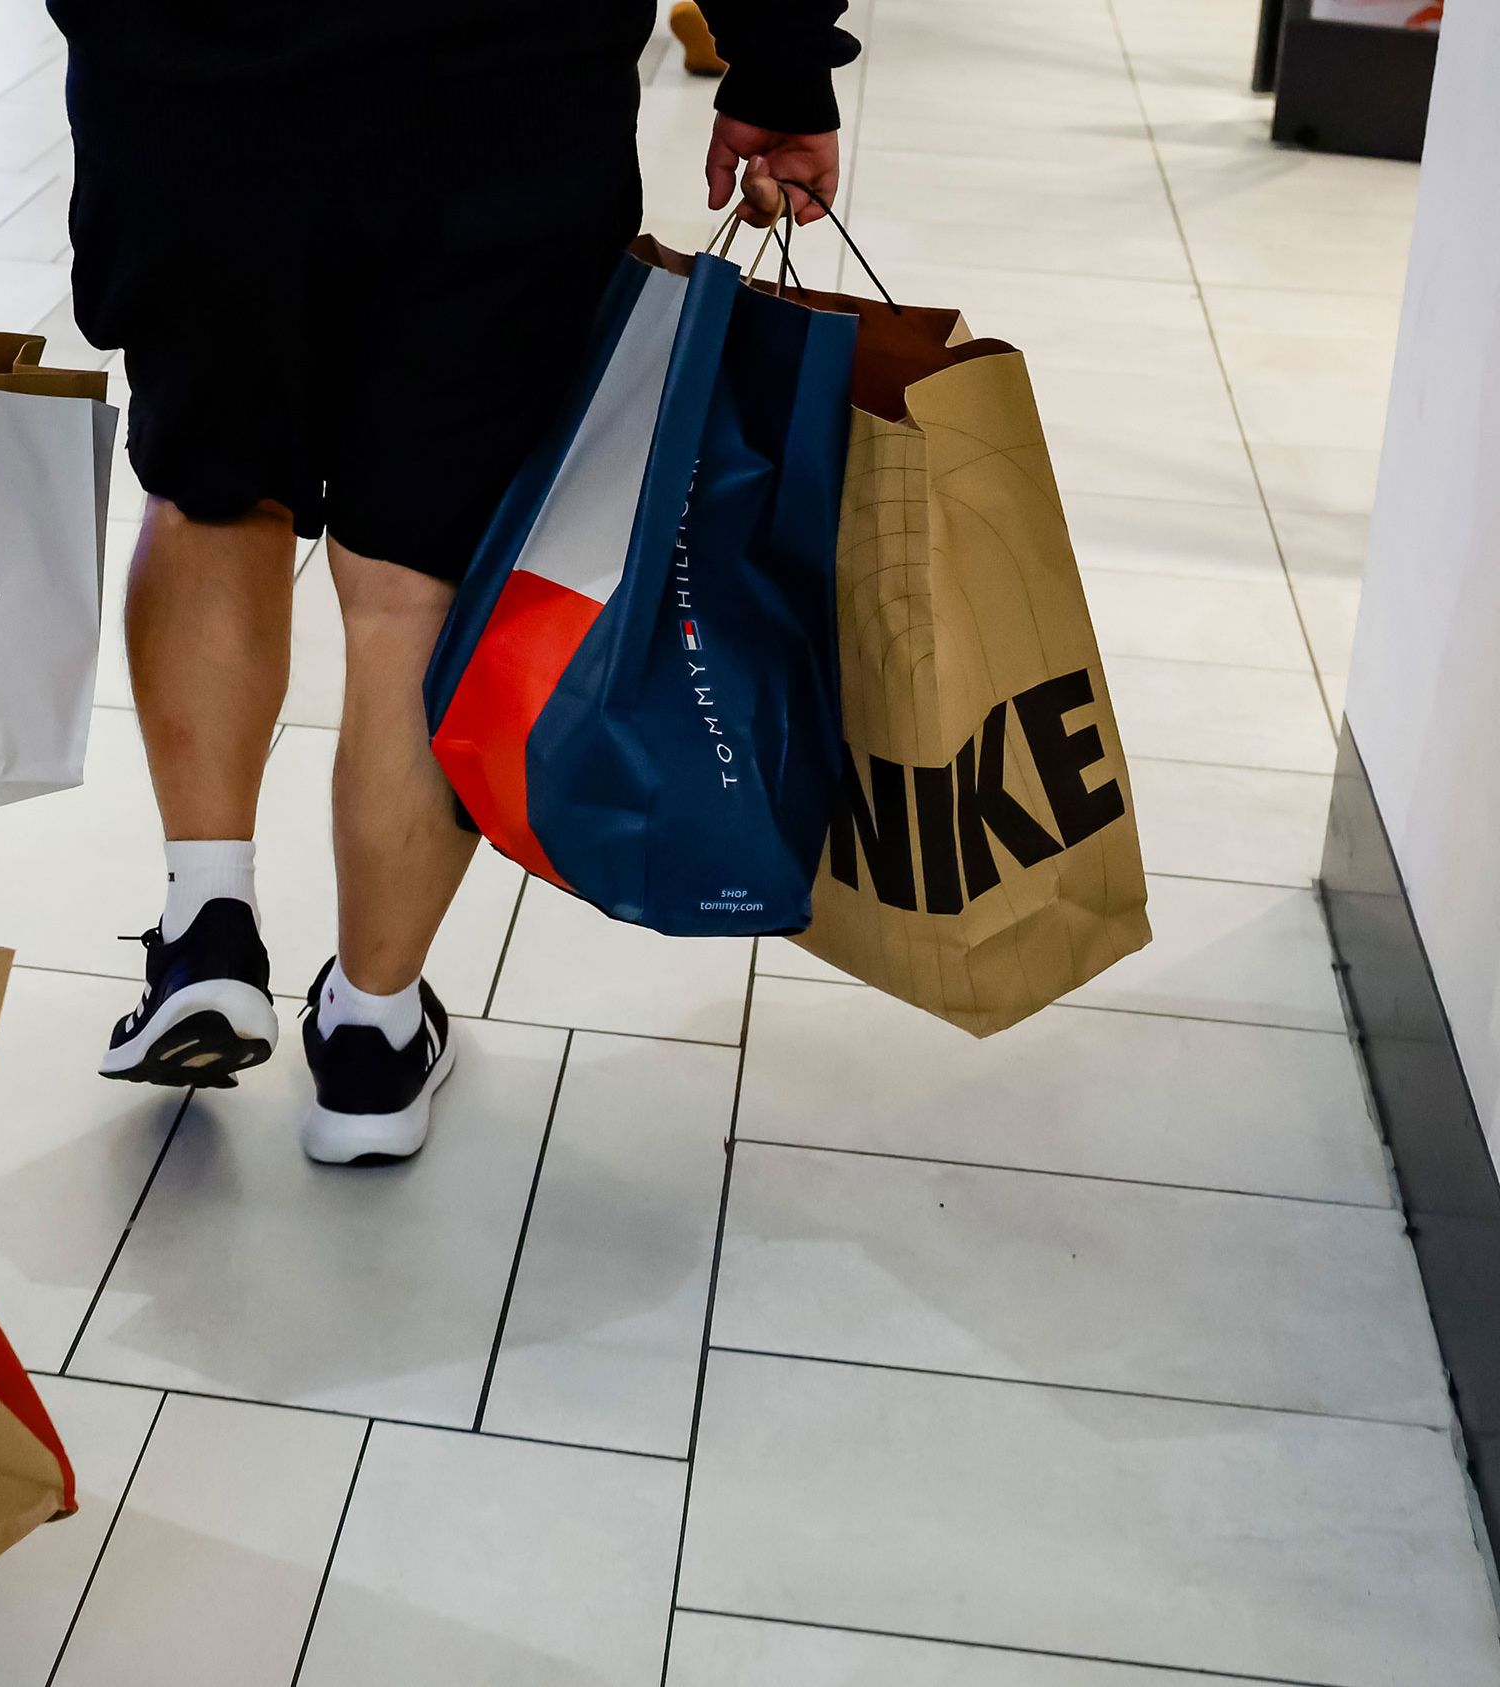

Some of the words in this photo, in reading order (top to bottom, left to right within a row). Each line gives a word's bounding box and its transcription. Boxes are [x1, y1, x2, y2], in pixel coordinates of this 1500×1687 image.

[688, 660, 738, 788] TOMMY
[829, 667, 1126, 916] NIKE
[700, 902, 764, 913] tommy.com
[720, 889, 748, 898] SHOP
